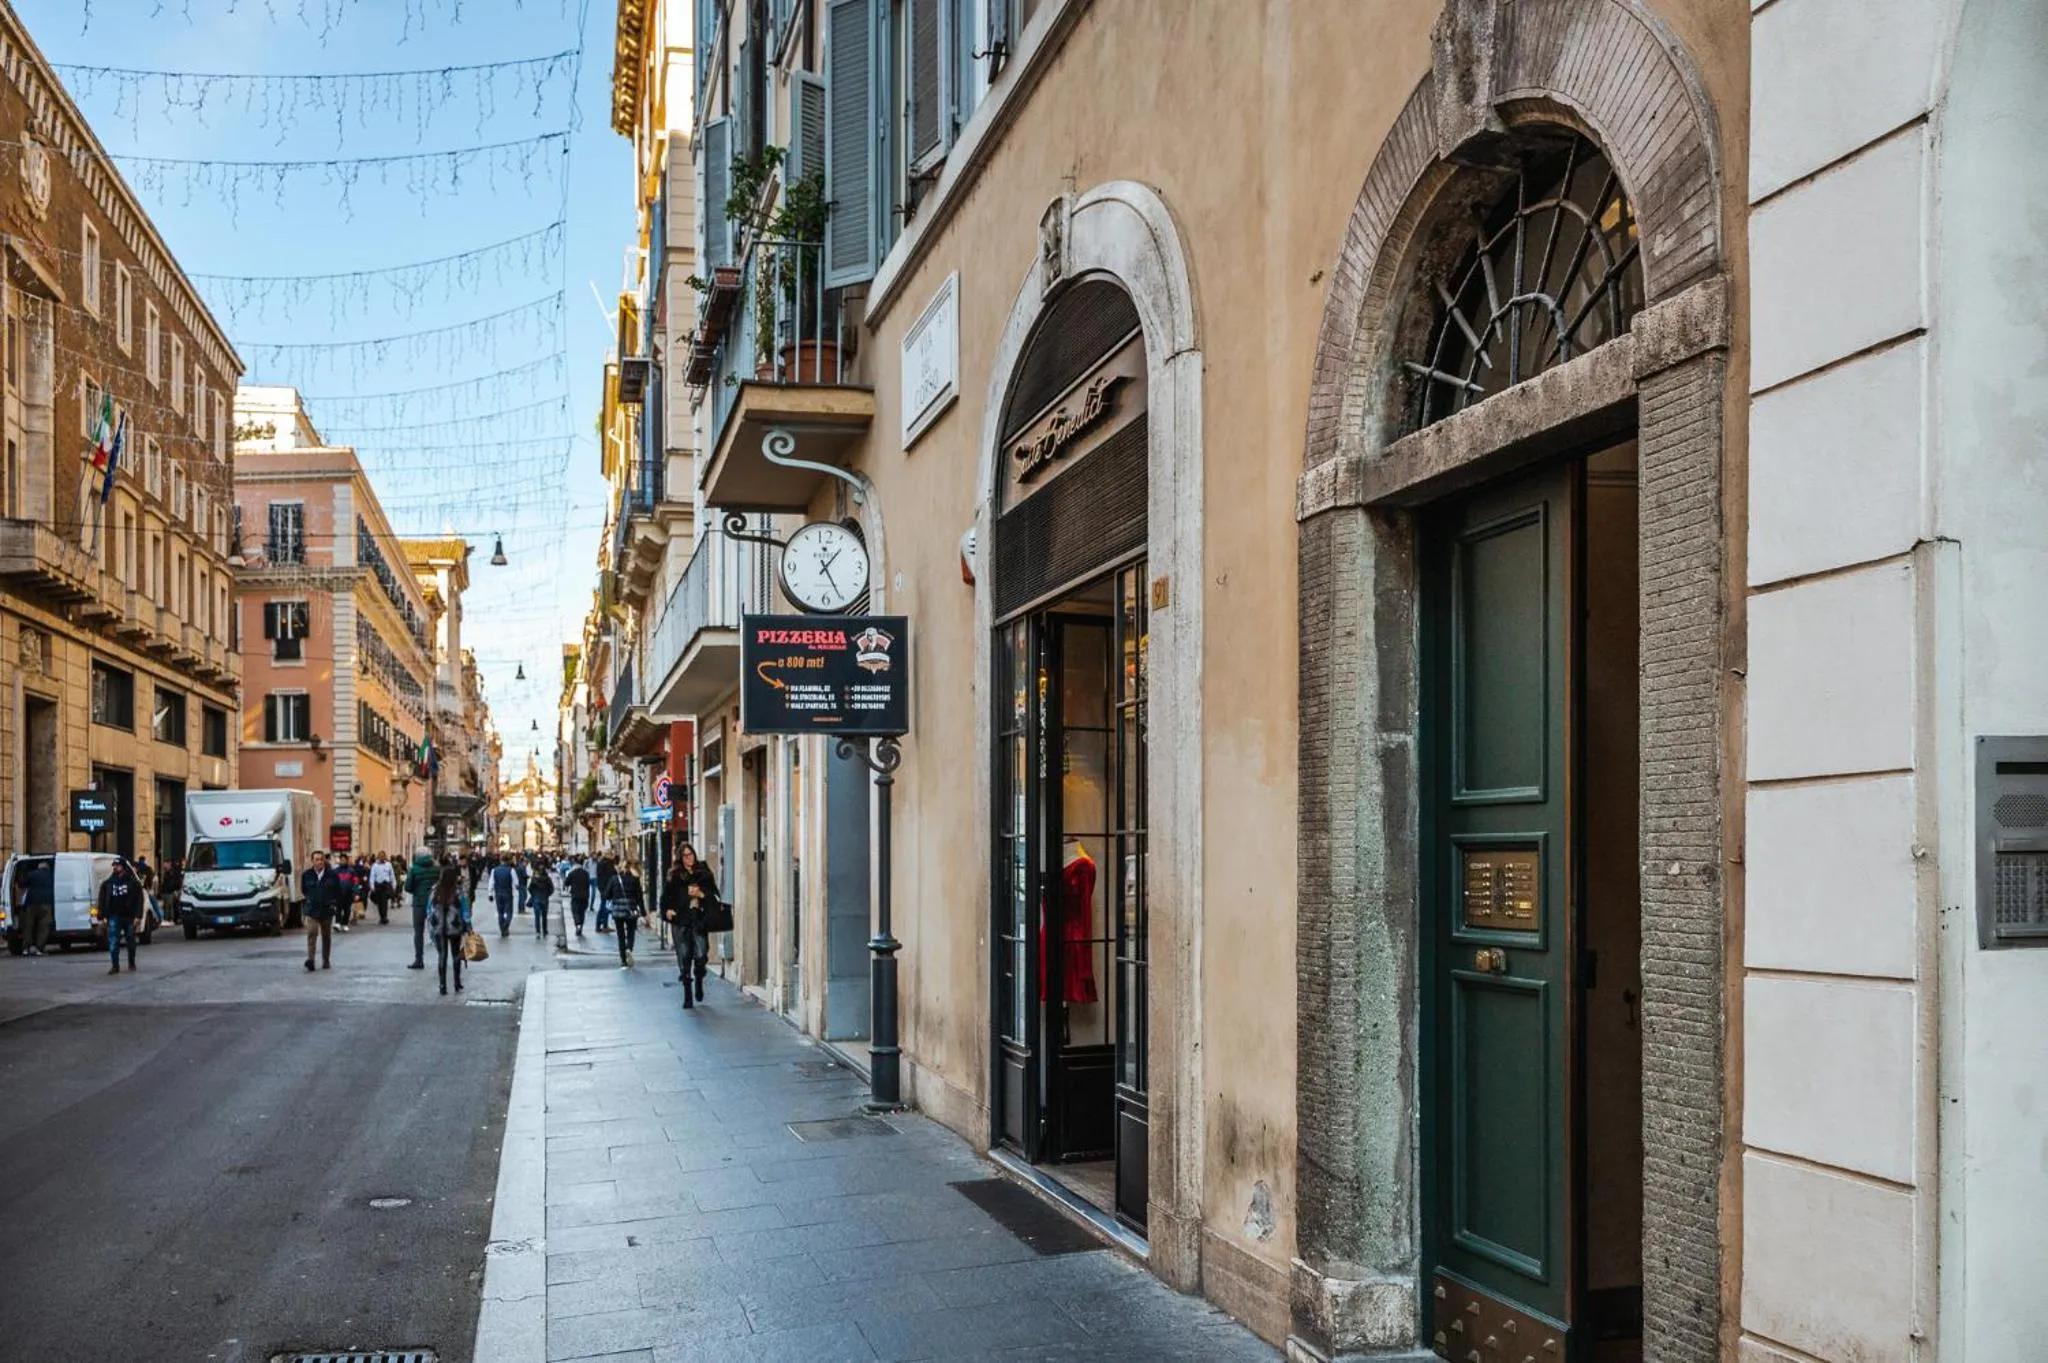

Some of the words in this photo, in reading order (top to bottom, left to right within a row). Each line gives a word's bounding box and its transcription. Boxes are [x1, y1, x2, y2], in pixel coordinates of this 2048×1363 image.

[818, 530, 833, 544] 12
[788, 561, 797, 574] 9
[855, 560, 863, 575] 3
[821, 592, 831, 606] 6
[756, 630, 847, 645] PIZZERIA
[787, 656, 805, 669] 800
